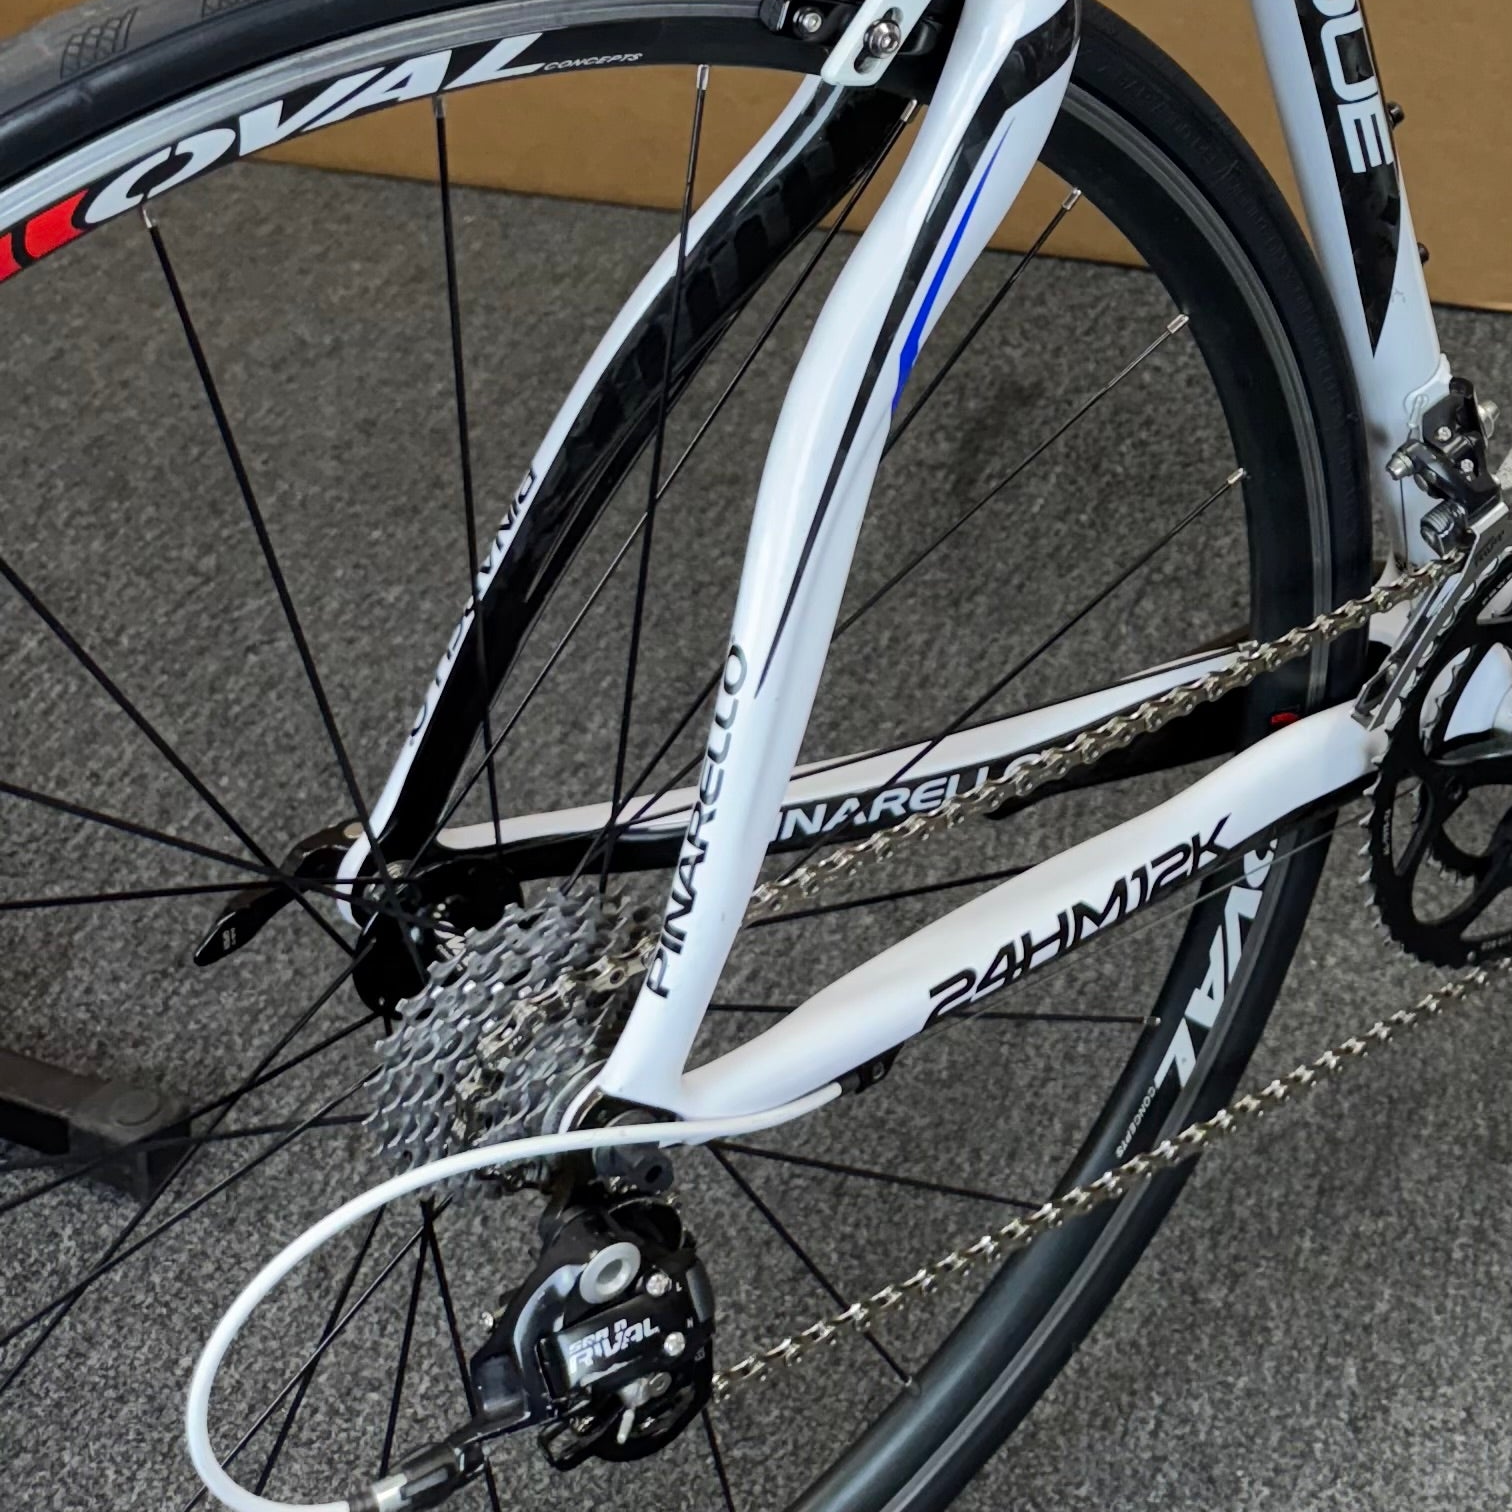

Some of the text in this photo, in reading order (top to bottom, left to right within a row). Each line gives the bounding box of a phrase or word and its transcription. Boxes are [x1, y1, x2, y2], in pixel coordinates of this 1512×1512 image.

[84, 33, 644, 224] OVAL CONCEPTS
[646, 644, 748, 1000] PINARELLO
[921, 813, 1233, 1032] 24HM12K
[1114, 1085, 1157, 1160] CONCEPTS
[568, 1317, 661, 1375] RIVAL
